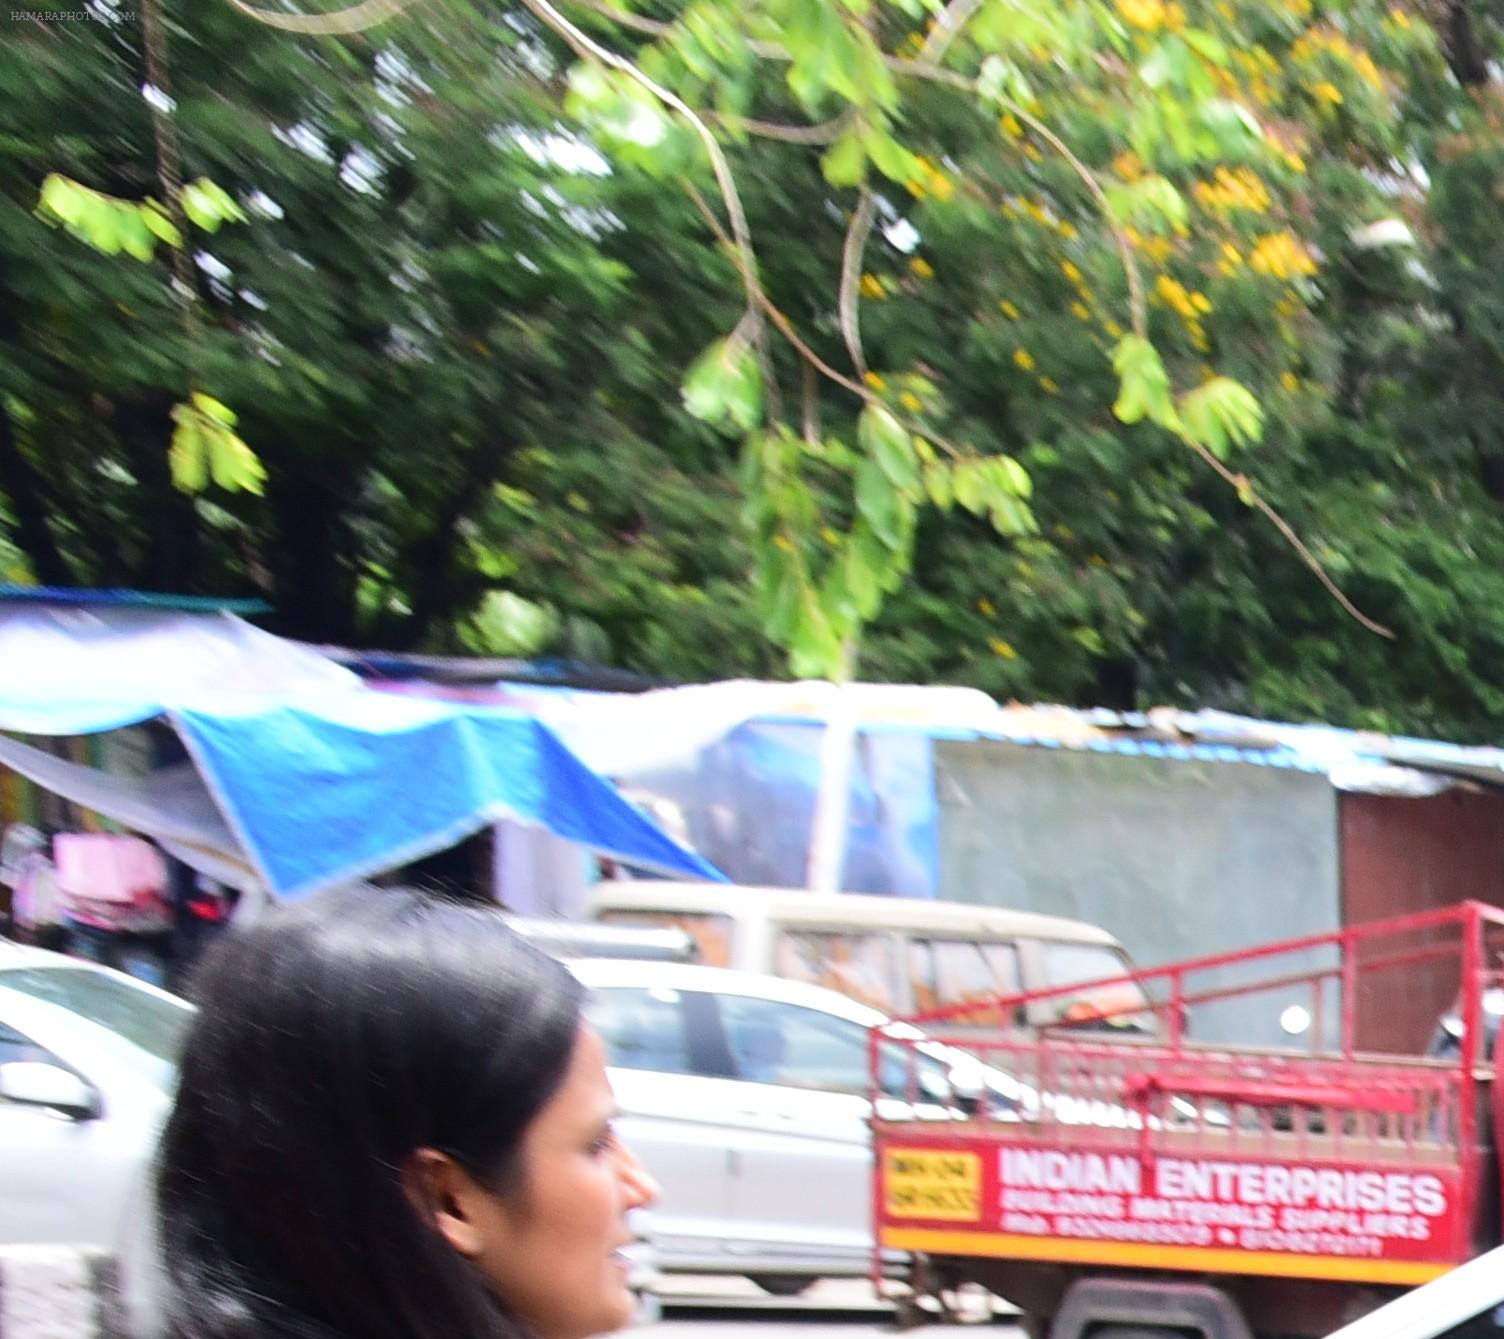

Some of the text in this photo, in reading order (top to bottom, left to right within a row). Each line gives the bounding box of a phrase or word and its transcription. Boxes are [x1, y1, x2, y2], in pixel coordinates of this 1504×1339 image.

[1001, 1147, 1447, 1217] INDIAN ENTERPRISES
[1280, 1206, 1431, 1241] SUPPLIERS
